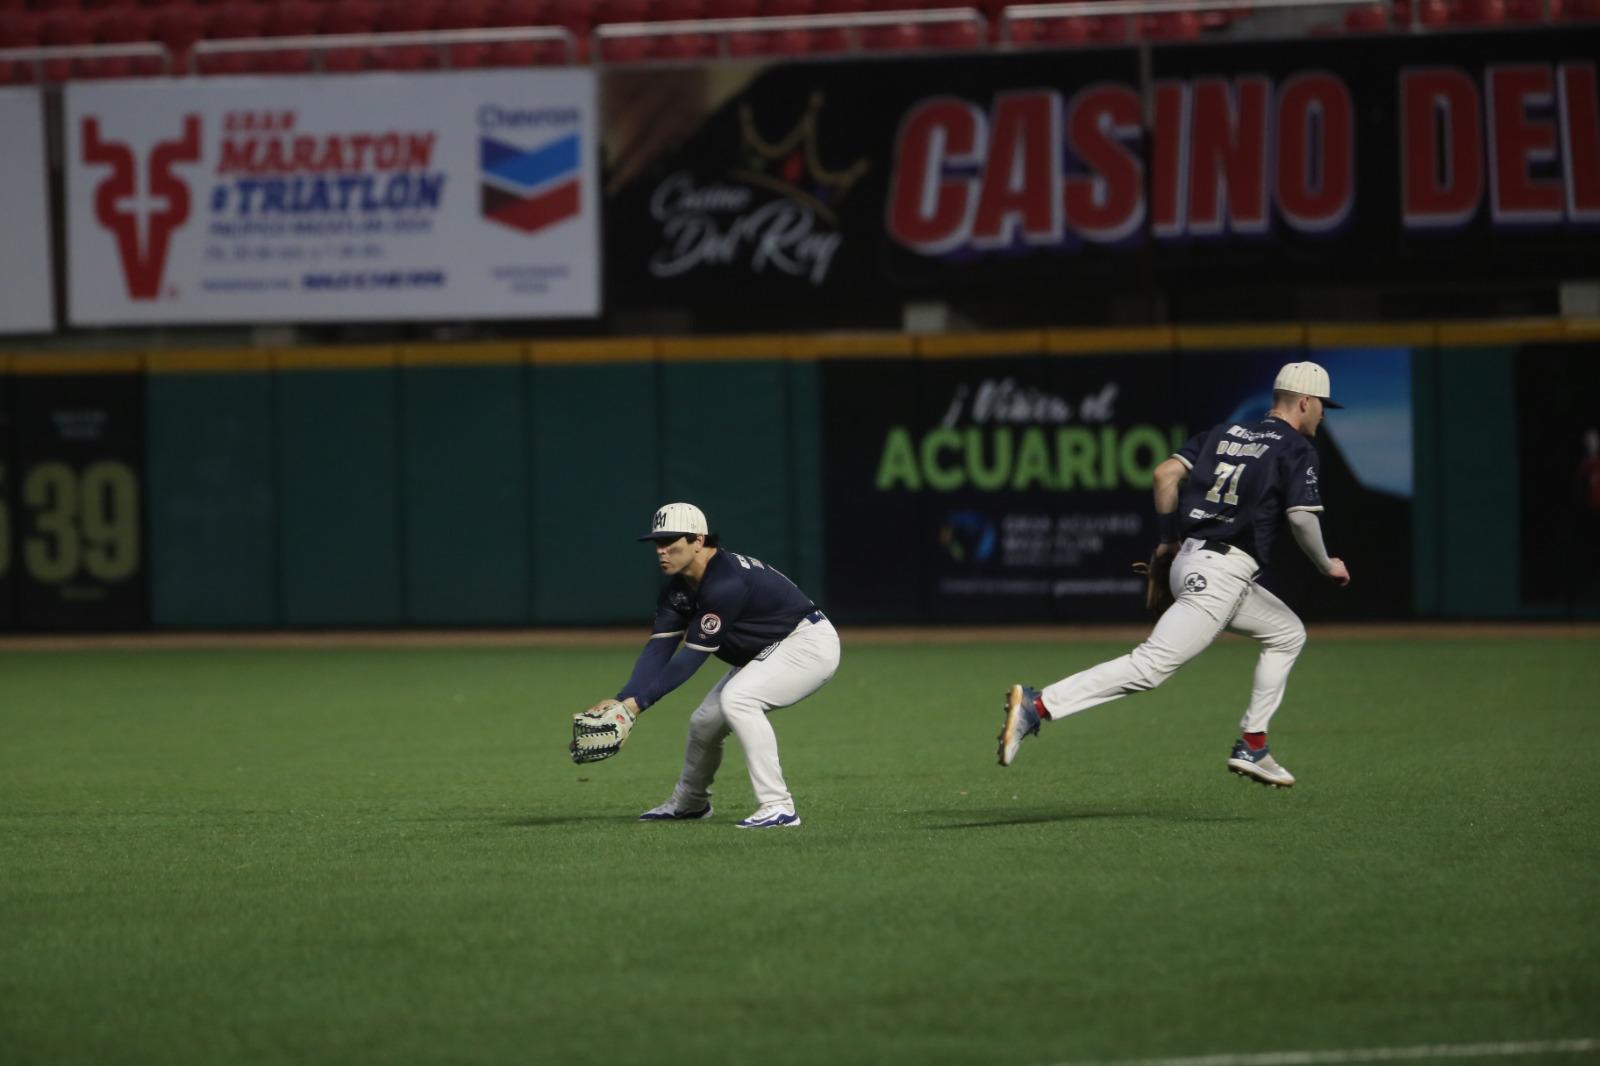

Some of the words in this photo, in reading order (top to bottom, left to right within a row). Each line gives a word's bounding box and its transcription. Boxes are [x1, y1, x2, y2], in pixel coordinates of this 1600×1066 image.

[886, 72, 1355, 258] CASINO
[24, 462, 138, 582] 39
[1205, 461, 1246, 506] 71
